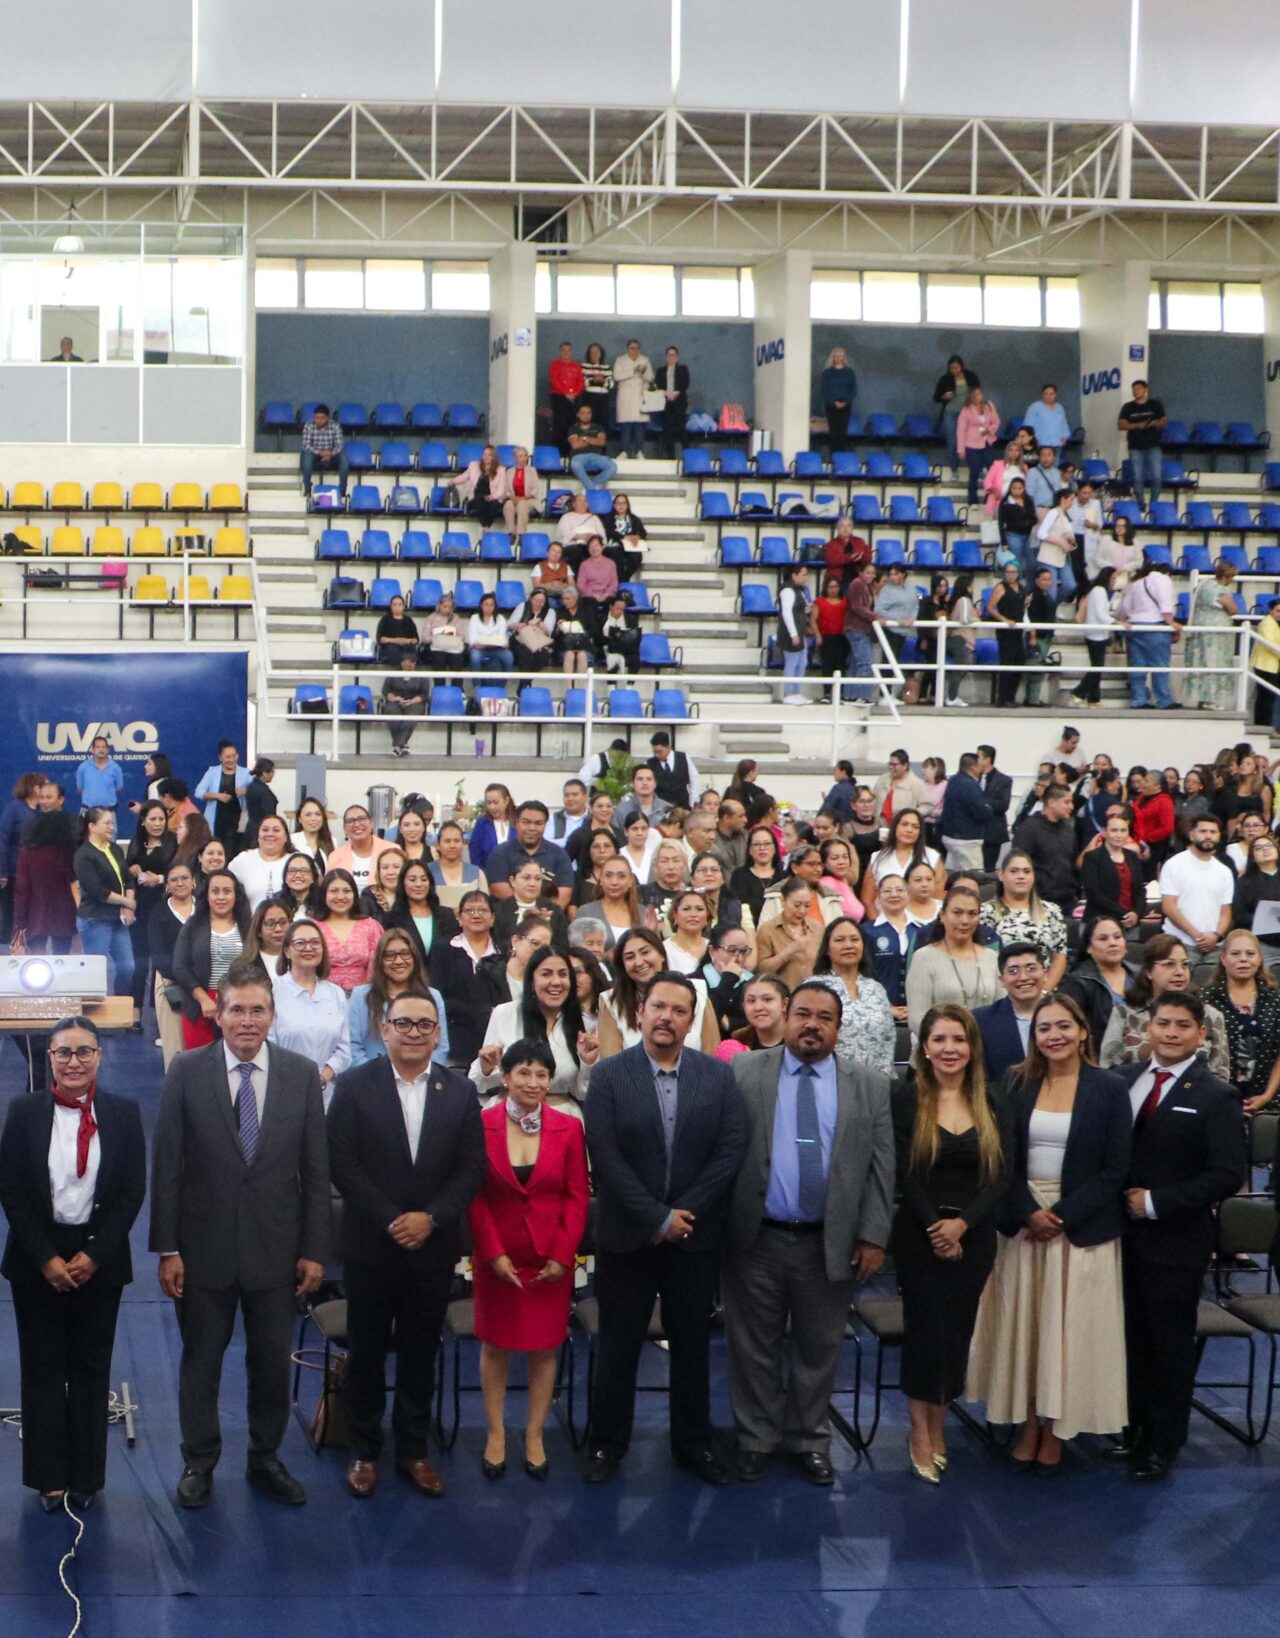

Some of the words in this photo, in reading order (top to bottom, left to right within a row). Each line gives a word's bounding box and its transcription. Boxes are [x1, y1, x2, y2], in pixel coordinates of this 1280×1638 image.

[757, 338, 785, 367] UVAQ
[1083, 367, 1121, 395] UVAQ
[36, 721, 159, 753] UVAQ
